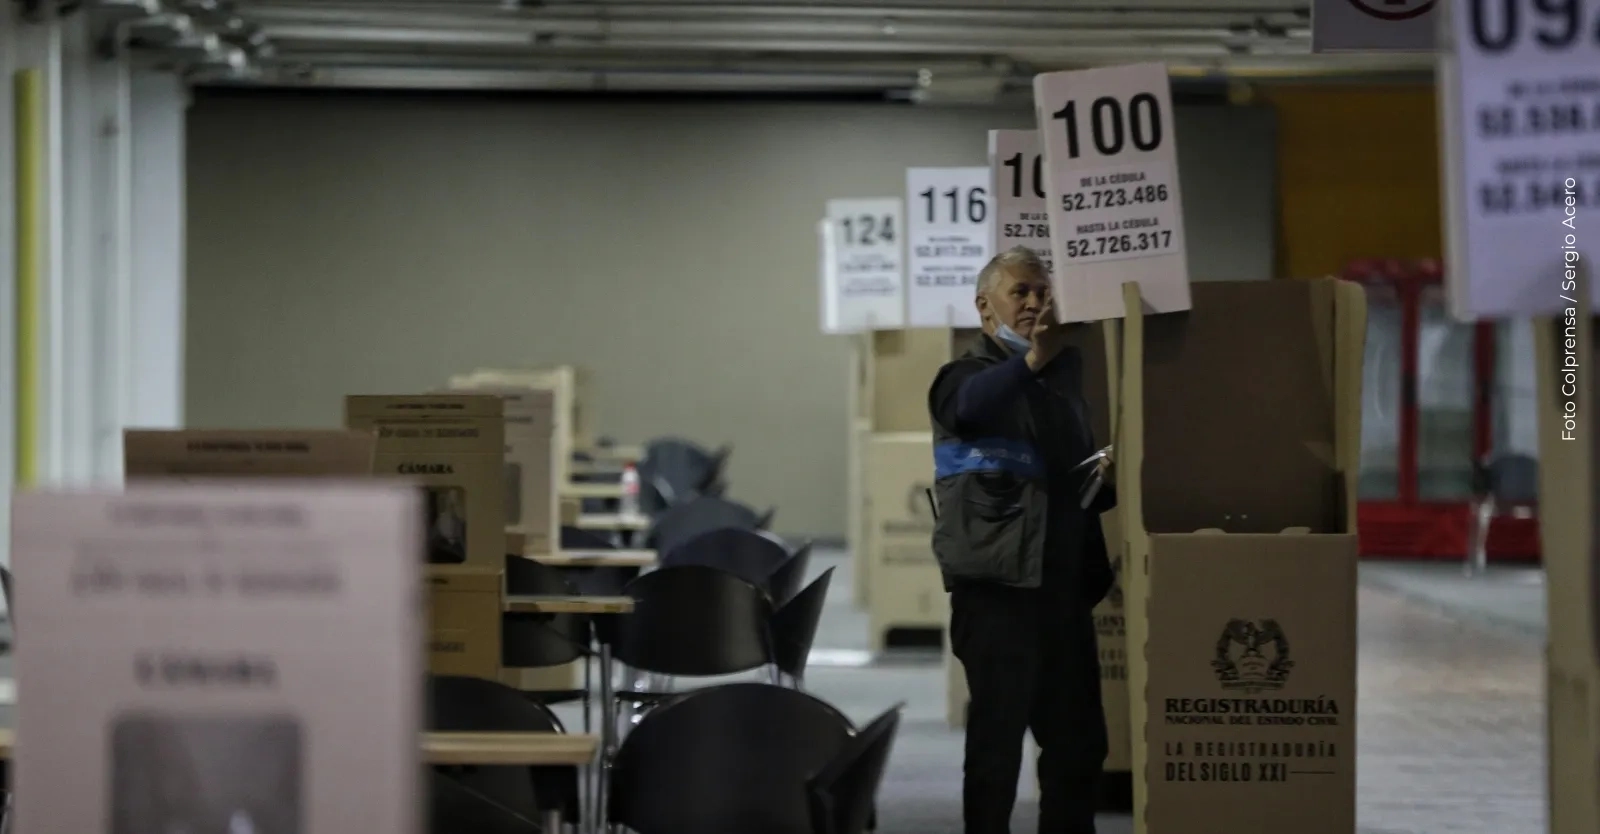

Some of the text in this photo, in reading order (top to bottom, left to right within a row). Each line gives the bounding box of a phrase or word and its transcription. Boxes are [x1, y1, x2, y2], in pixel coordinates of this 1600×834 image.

[1052, 92, 1162, 159] 100
[1080, 176, 1092, 187] DE
[1095, 175, 1107, 186] LA
[919, 186, 986, 223] 116
[1062, 184, 1168, 212] 52.723.486
[842, 214, 895, 246] 124
[1076, 221, 1105, 235] HASTA
[1108, 221, 1120, 232] LA
[1067, 230, 1172, 258] 52.726.317
[1165, 695, 1339, 715] REGISTRADURÍA
[1165, 715, 1338, 726] NACIONAL DEL ESTADO CIVIL
[1165, 741, 1336, 758] LA REGISTRADURÍA
[1165, 762, 1287, 782] DEL SIGLO XXI
